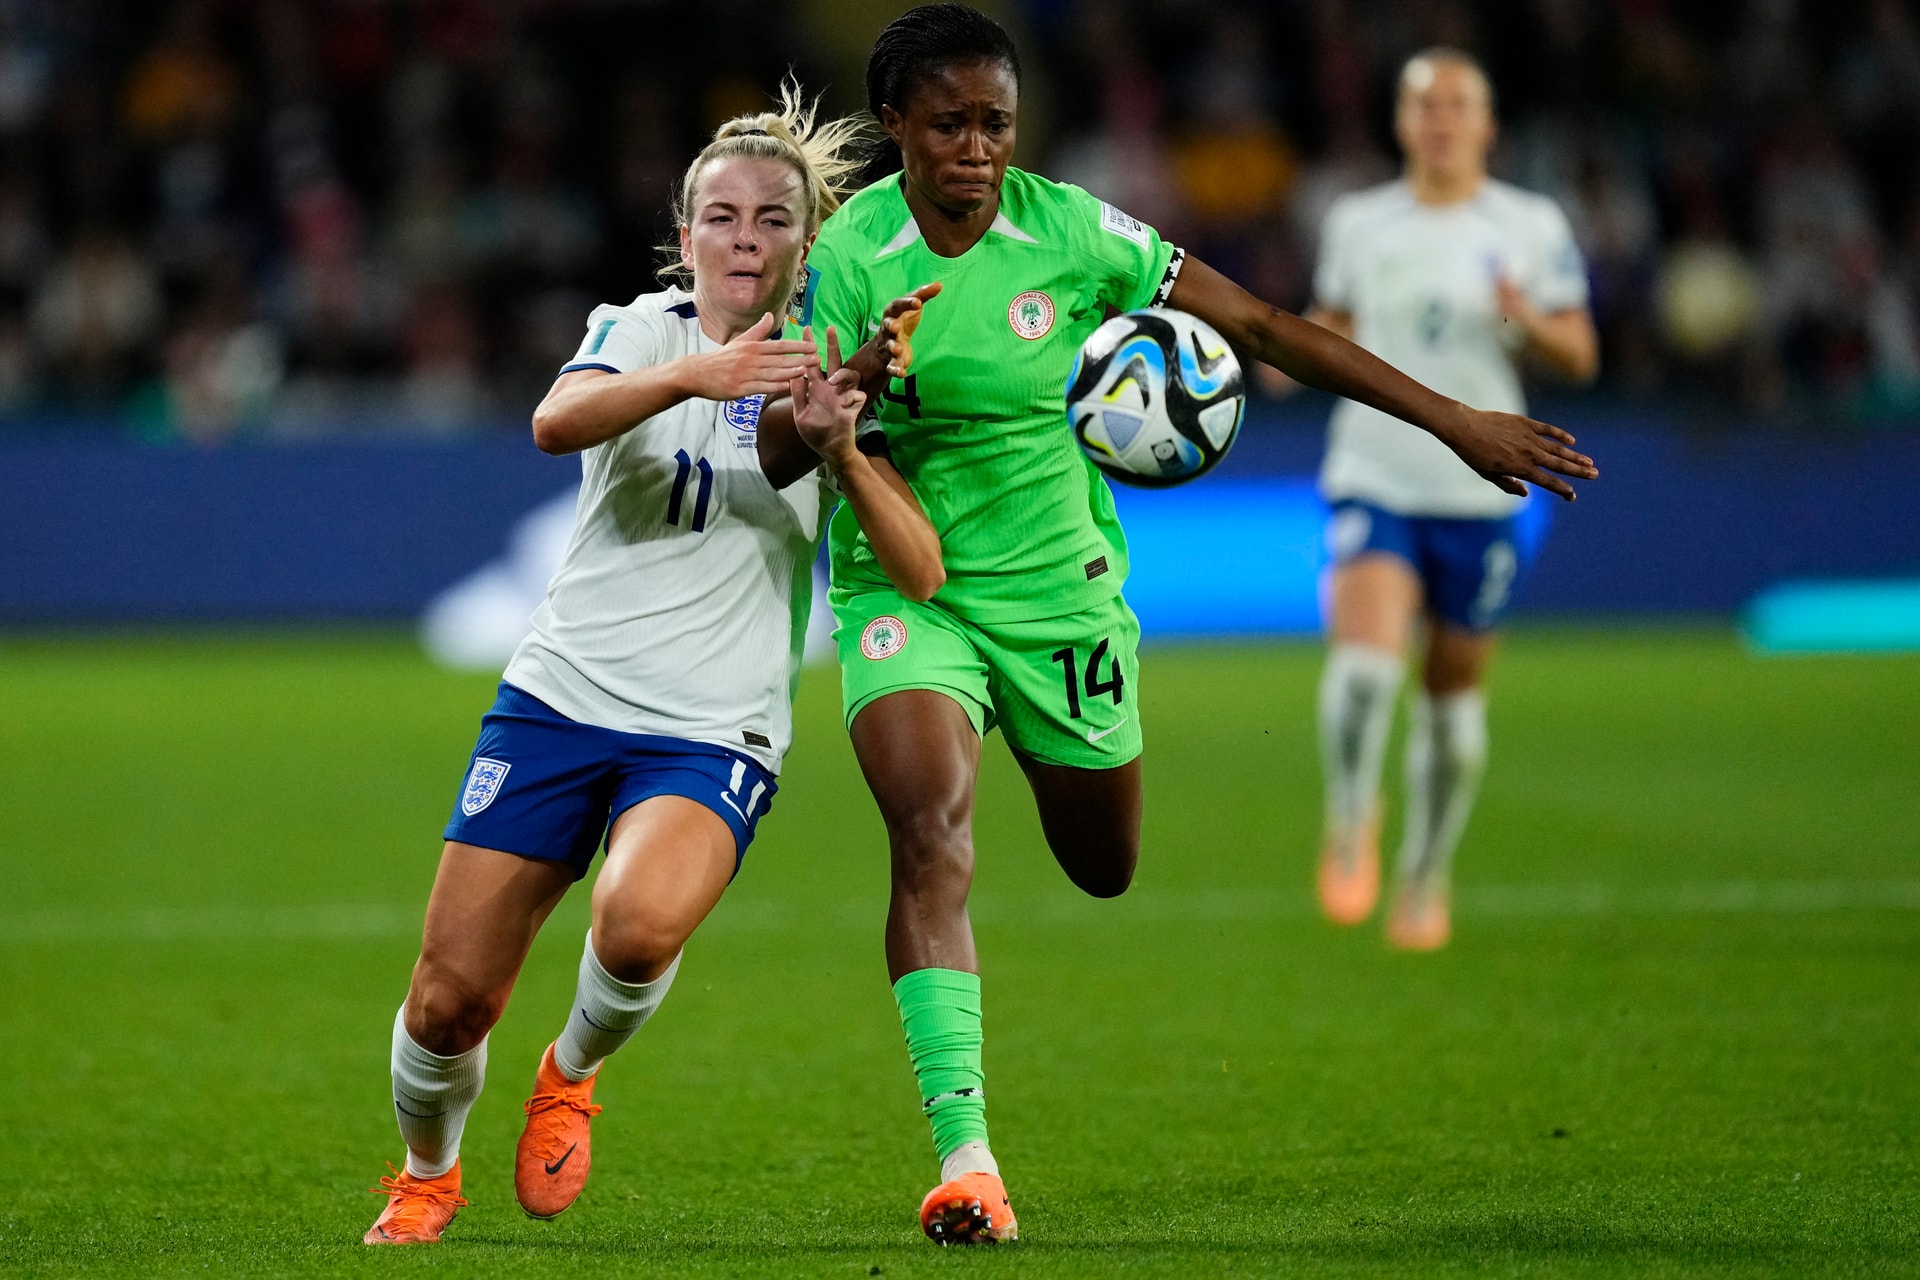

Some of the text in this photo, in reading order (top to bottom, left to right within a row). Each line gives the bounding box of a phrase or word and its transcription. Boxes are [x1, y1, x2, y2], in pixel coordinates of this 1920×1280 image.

[1010, 293, 1053, 333] NIGERIA FOOTBALL FEDERATION
[666, 448, 714, 533] 11
[862, 618, 905, 657] NIGERIA FOOTBALL FEDERATION
[1052, 637, 1124, 718] 14
[729, 758, 767, 819] 11
